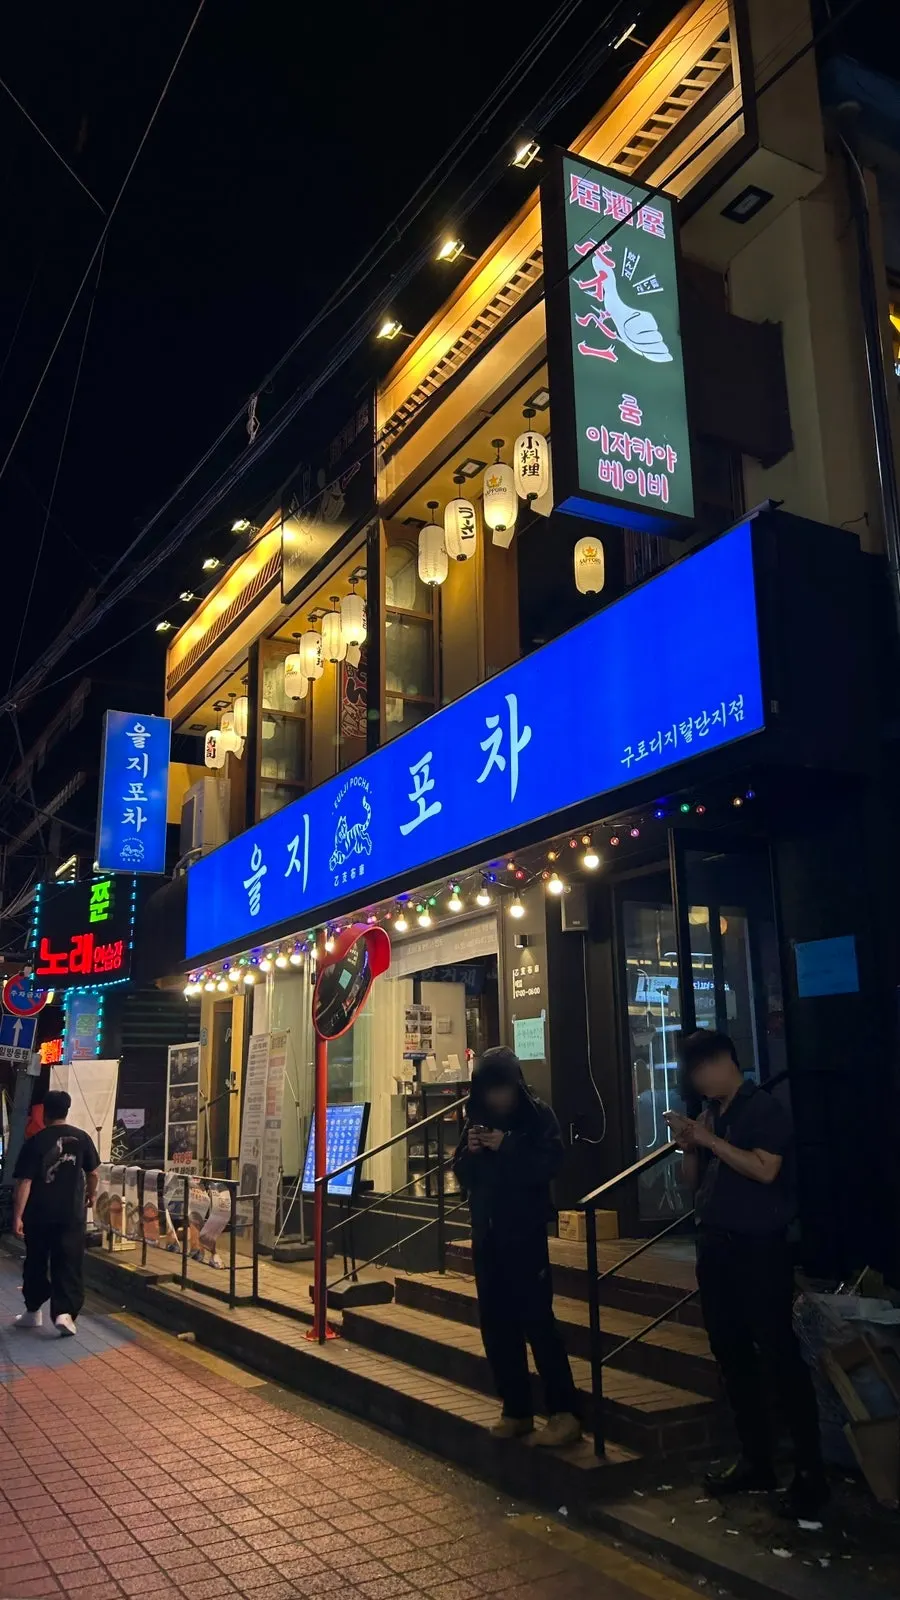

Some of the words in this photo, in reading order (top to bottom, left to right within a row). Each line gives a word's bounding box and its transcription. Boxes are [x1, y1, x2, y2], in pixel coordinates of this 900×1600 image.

[569, 173, 666, 240] 居酒屋
[617, 393, 643, 426] 룸
[520, 436, 541, 477] 小料理
[586, 425, 677, 473] 이자카야
[597, 459, 670, 504] 베이비
[620, 693, 745, 769] 구로디지털단지점
[121, 722, 151, 833] 을지포차
[333, 782, 350, 810] EULJI
[349, 775, 370, 793] POCHA
[243, 813, 310, 917] 을지
[399, 693, 532, 836] 포차
[10, 989, 42, 999] 주차금지
